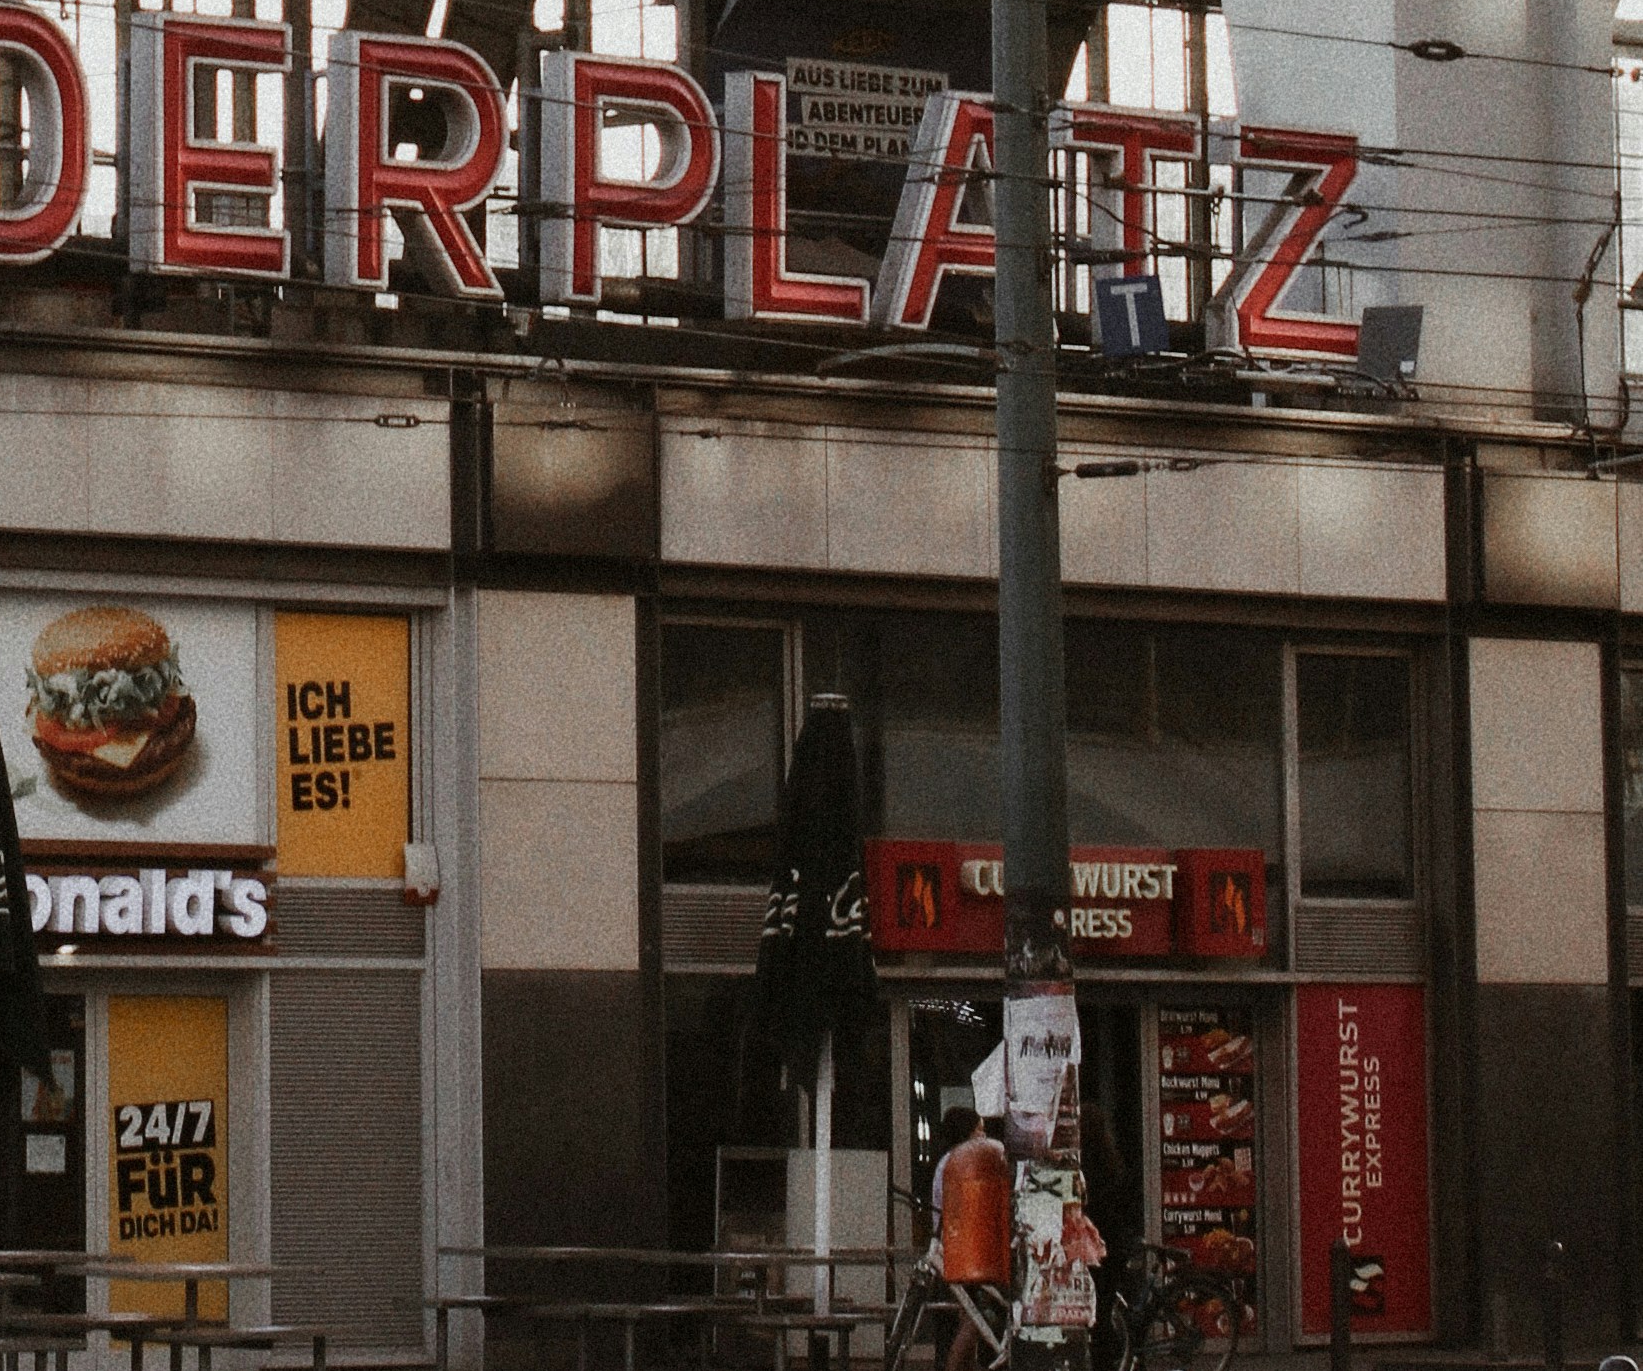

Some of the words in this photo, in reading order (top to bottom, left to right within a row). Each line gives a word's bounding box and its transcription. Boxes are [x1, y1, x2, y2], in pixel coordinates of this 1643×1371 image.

[792, 64, 835, 88] AUS
[840, 68, 894, 94] LIEBE
[898, 74, 943, 99] ZUM
[814, 131, 857, 155] DEM
[287, 680, 351, 722] ICH
[288, 721, 396, 766] LIEBE
[291, 770, 351, 812] ES!
[964, 859, 1178, 900] CUWURST
[119, 1100, 213, 1148] 24/7
[1338, 998, 1363, 1247] CURRYWURST
[1363, 1056, 1383, 1188] EXPRESS
[119, 1213, 176, 1241] DICH
[180, 1208, 220, 1235] DA!
